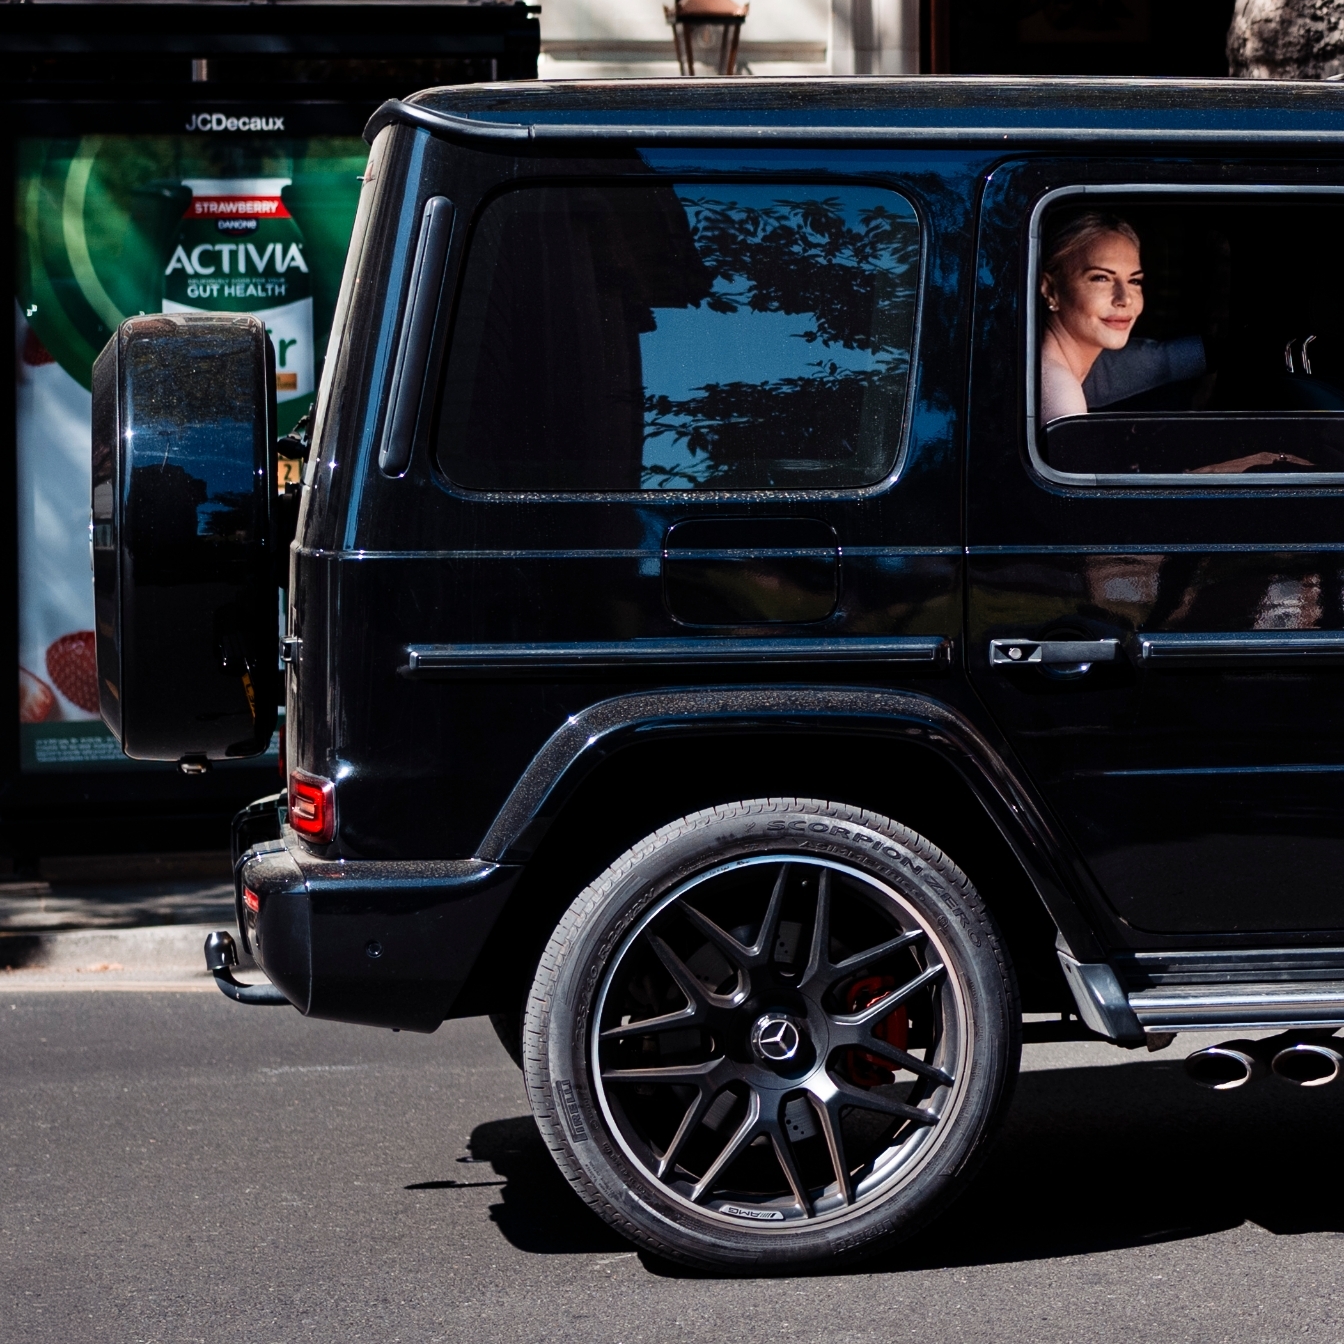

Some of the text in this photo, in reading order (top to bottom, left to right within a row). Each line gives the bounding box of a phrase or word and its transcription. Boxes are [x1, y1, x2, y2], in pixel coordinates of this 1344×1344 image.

[185, 113, 285, 131] JCDecaux
[194, 200, 279, 214] STRAWBERRY
[165, 242, 310, 275] ACTIVIA
[187, 284, 286, 298] GUT HEALTH
[765, 817, 983, 949] SCORPION ZERO
[554, 1078, 589, 1146] PIRELLI
[728, 1206, 761, 1218] AMG
